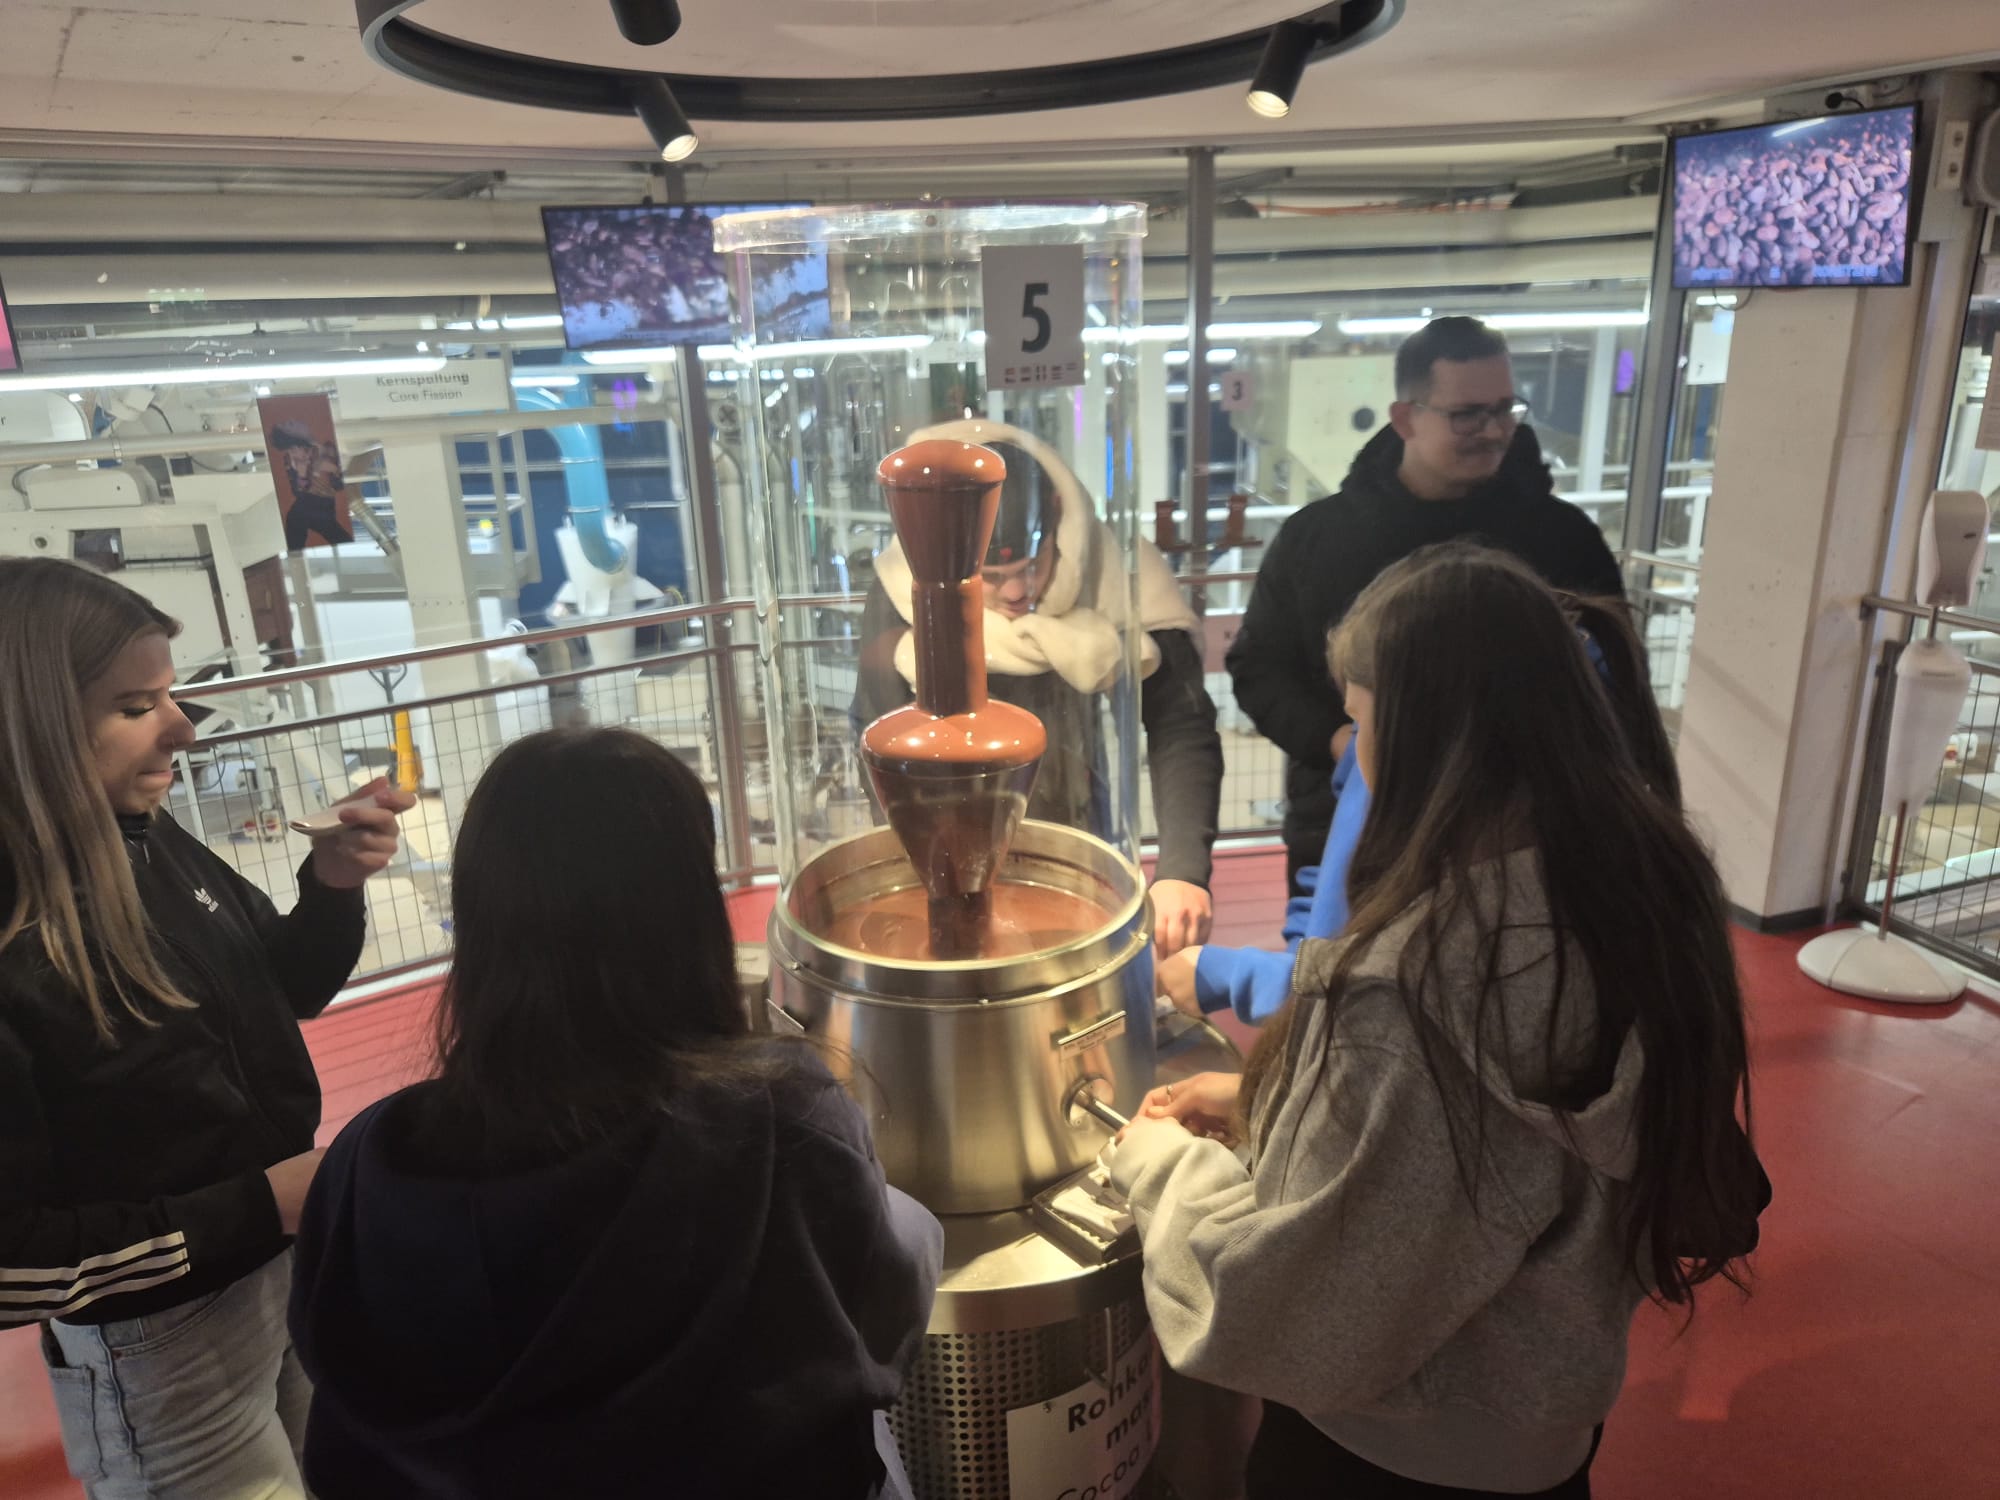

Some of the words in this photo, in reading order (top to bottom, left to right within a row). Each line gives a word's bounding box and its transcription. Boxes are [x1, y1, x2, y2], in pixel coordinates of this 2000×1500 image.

[1020, 282, 1052, 354] 5
[376, 373, 470, 387] Kernspaltung
[388, 391, 418, 402] Core
[423, 390, 462, 401] Fission
[1231, 380, 1243, 401] 3
